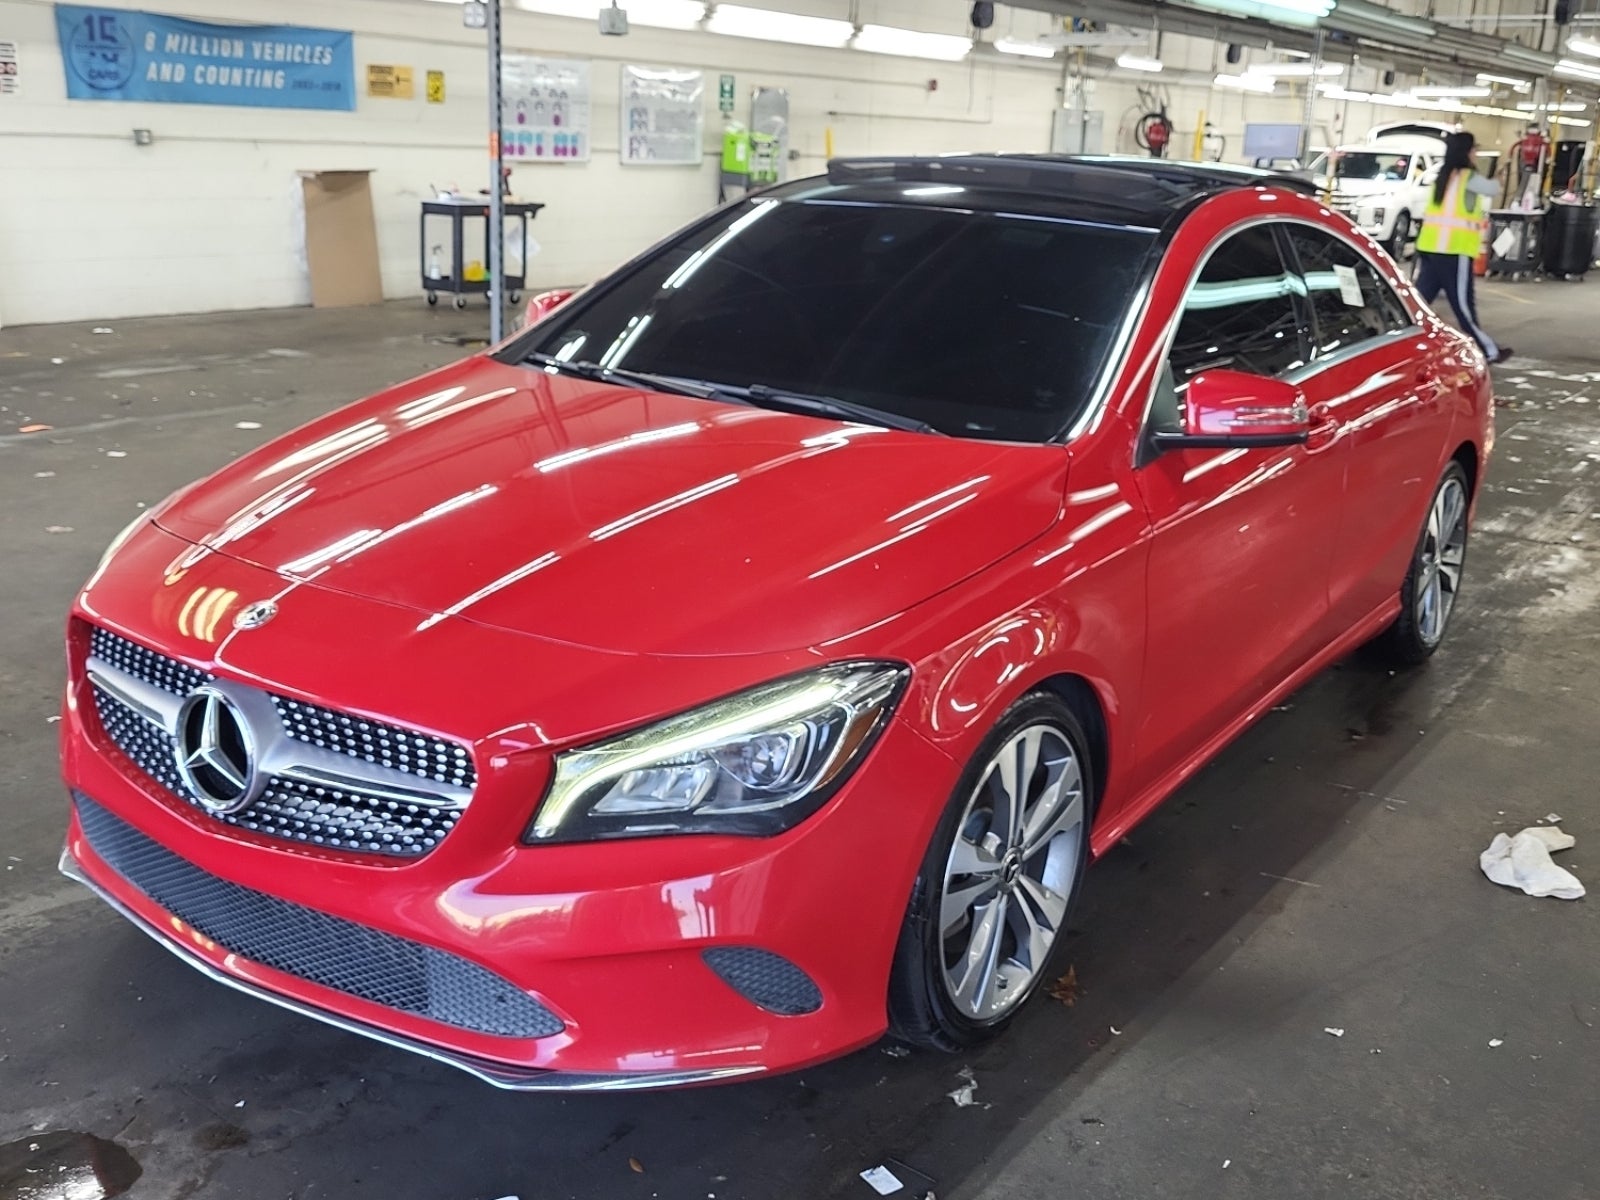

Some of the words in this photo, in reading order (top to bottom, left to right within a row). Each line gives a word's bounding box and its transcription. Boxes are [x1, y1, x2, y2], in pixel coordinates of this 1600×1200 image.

[164, 32, 244, 59] MILLION
[251, 40, 334, 66] VEHICLES
[146, 60, 186, 84] AND
[194, 64, 286, 90] COUNTING
